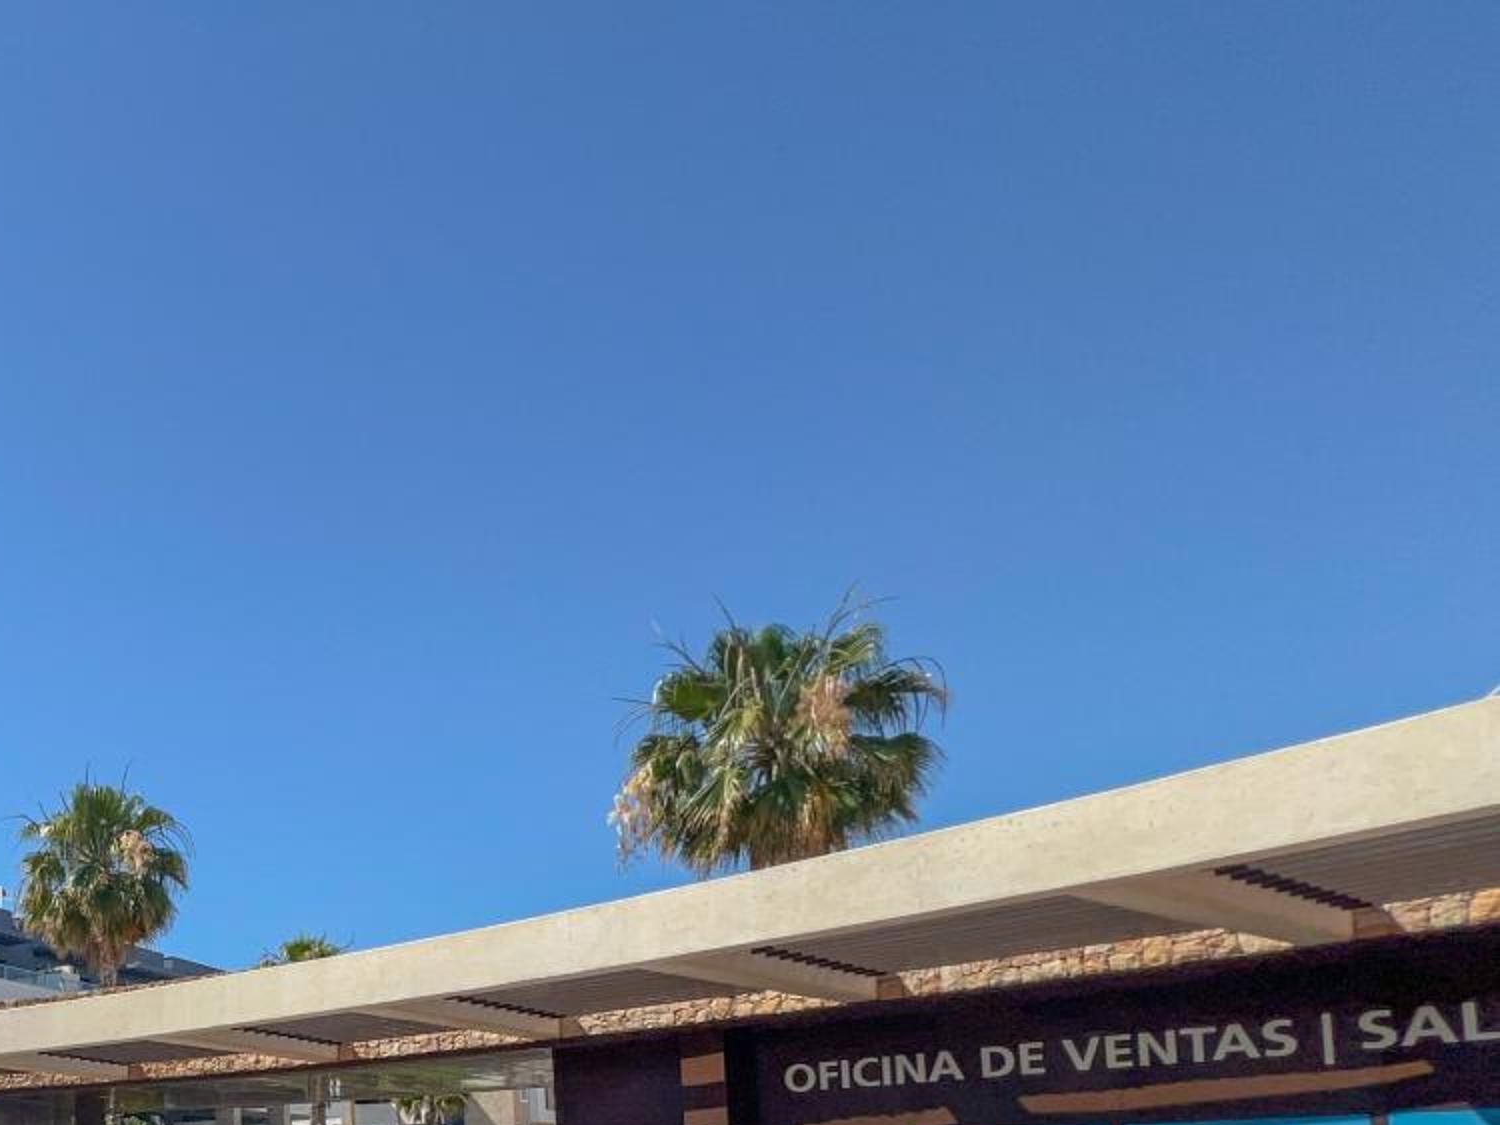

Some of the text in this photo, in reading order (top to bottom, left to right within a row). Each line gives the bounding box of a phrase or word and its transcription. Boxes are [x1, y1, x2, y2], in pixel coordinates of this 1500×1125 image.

[783, 1050, 965, 1093] OFICINA
[979, 1041, 1046, 1079] DE
[1061, 1019, 1298, 1072] VENTAS
[1357, 1001, 1500, 1049] SAL
